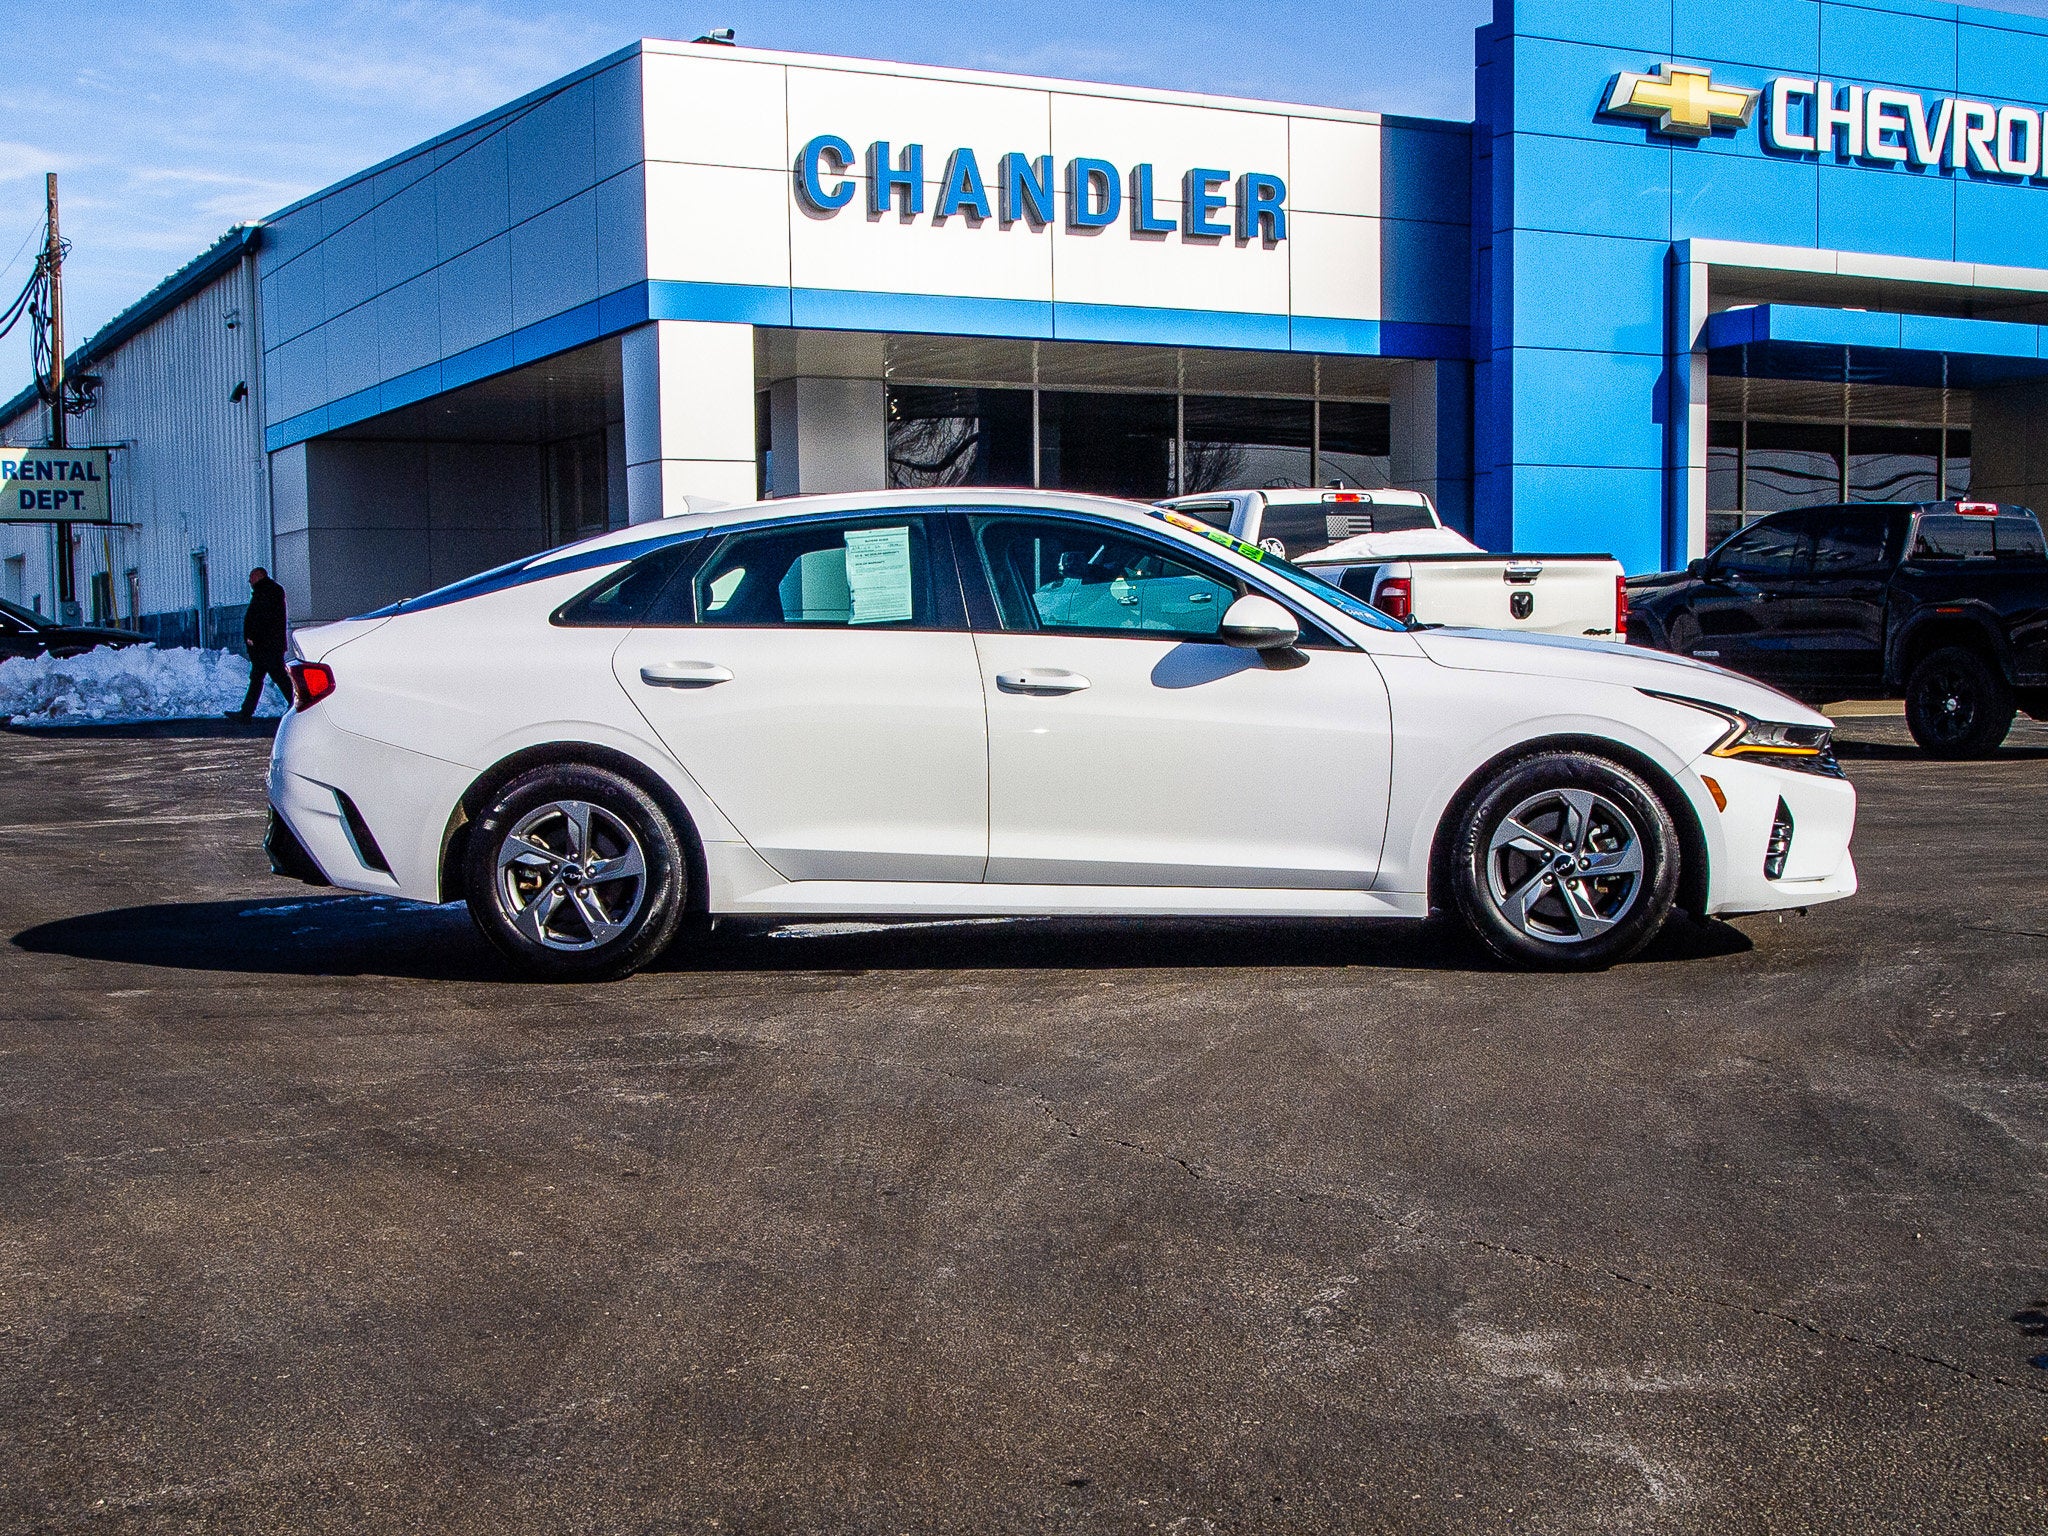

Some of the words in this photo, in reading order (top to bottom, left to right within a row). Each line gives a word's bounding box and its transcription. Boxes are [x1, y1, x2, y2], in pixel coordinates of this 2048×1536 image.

[1770, 77, 2048, 179] CHEVRO
[799, 134, 1287, 244] CHANDLER
[1, 460, 101, 481] RENTAL
[19, 489, 86, 510] DEPT.
